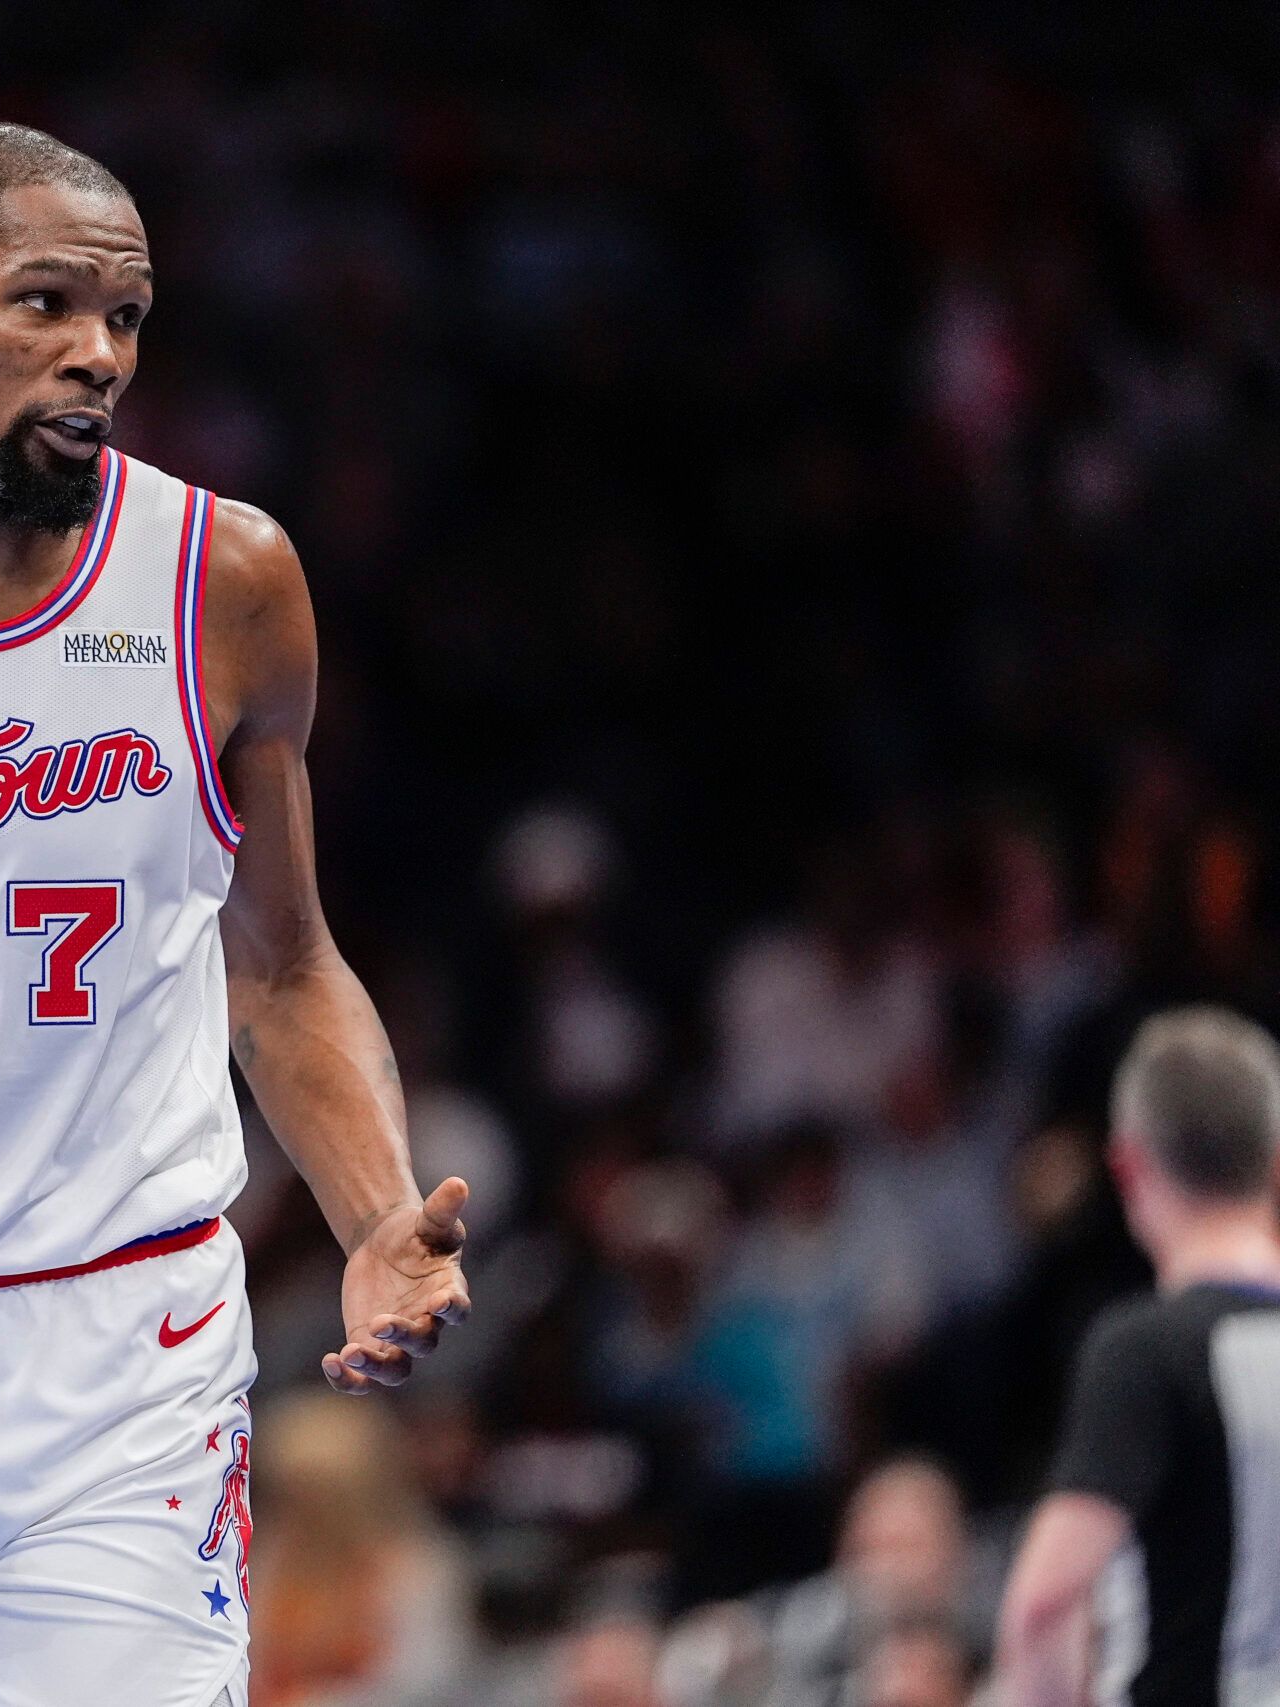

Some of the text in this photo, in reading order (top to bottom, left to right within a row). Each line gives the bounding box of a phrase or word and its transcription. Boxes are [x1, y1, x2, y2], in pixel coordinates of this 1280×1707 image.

[64, 633, 167, 650] MEMORIAL
[64, 647, 167, 664] HERMANN
[6, 879, 125, 1026] 7
